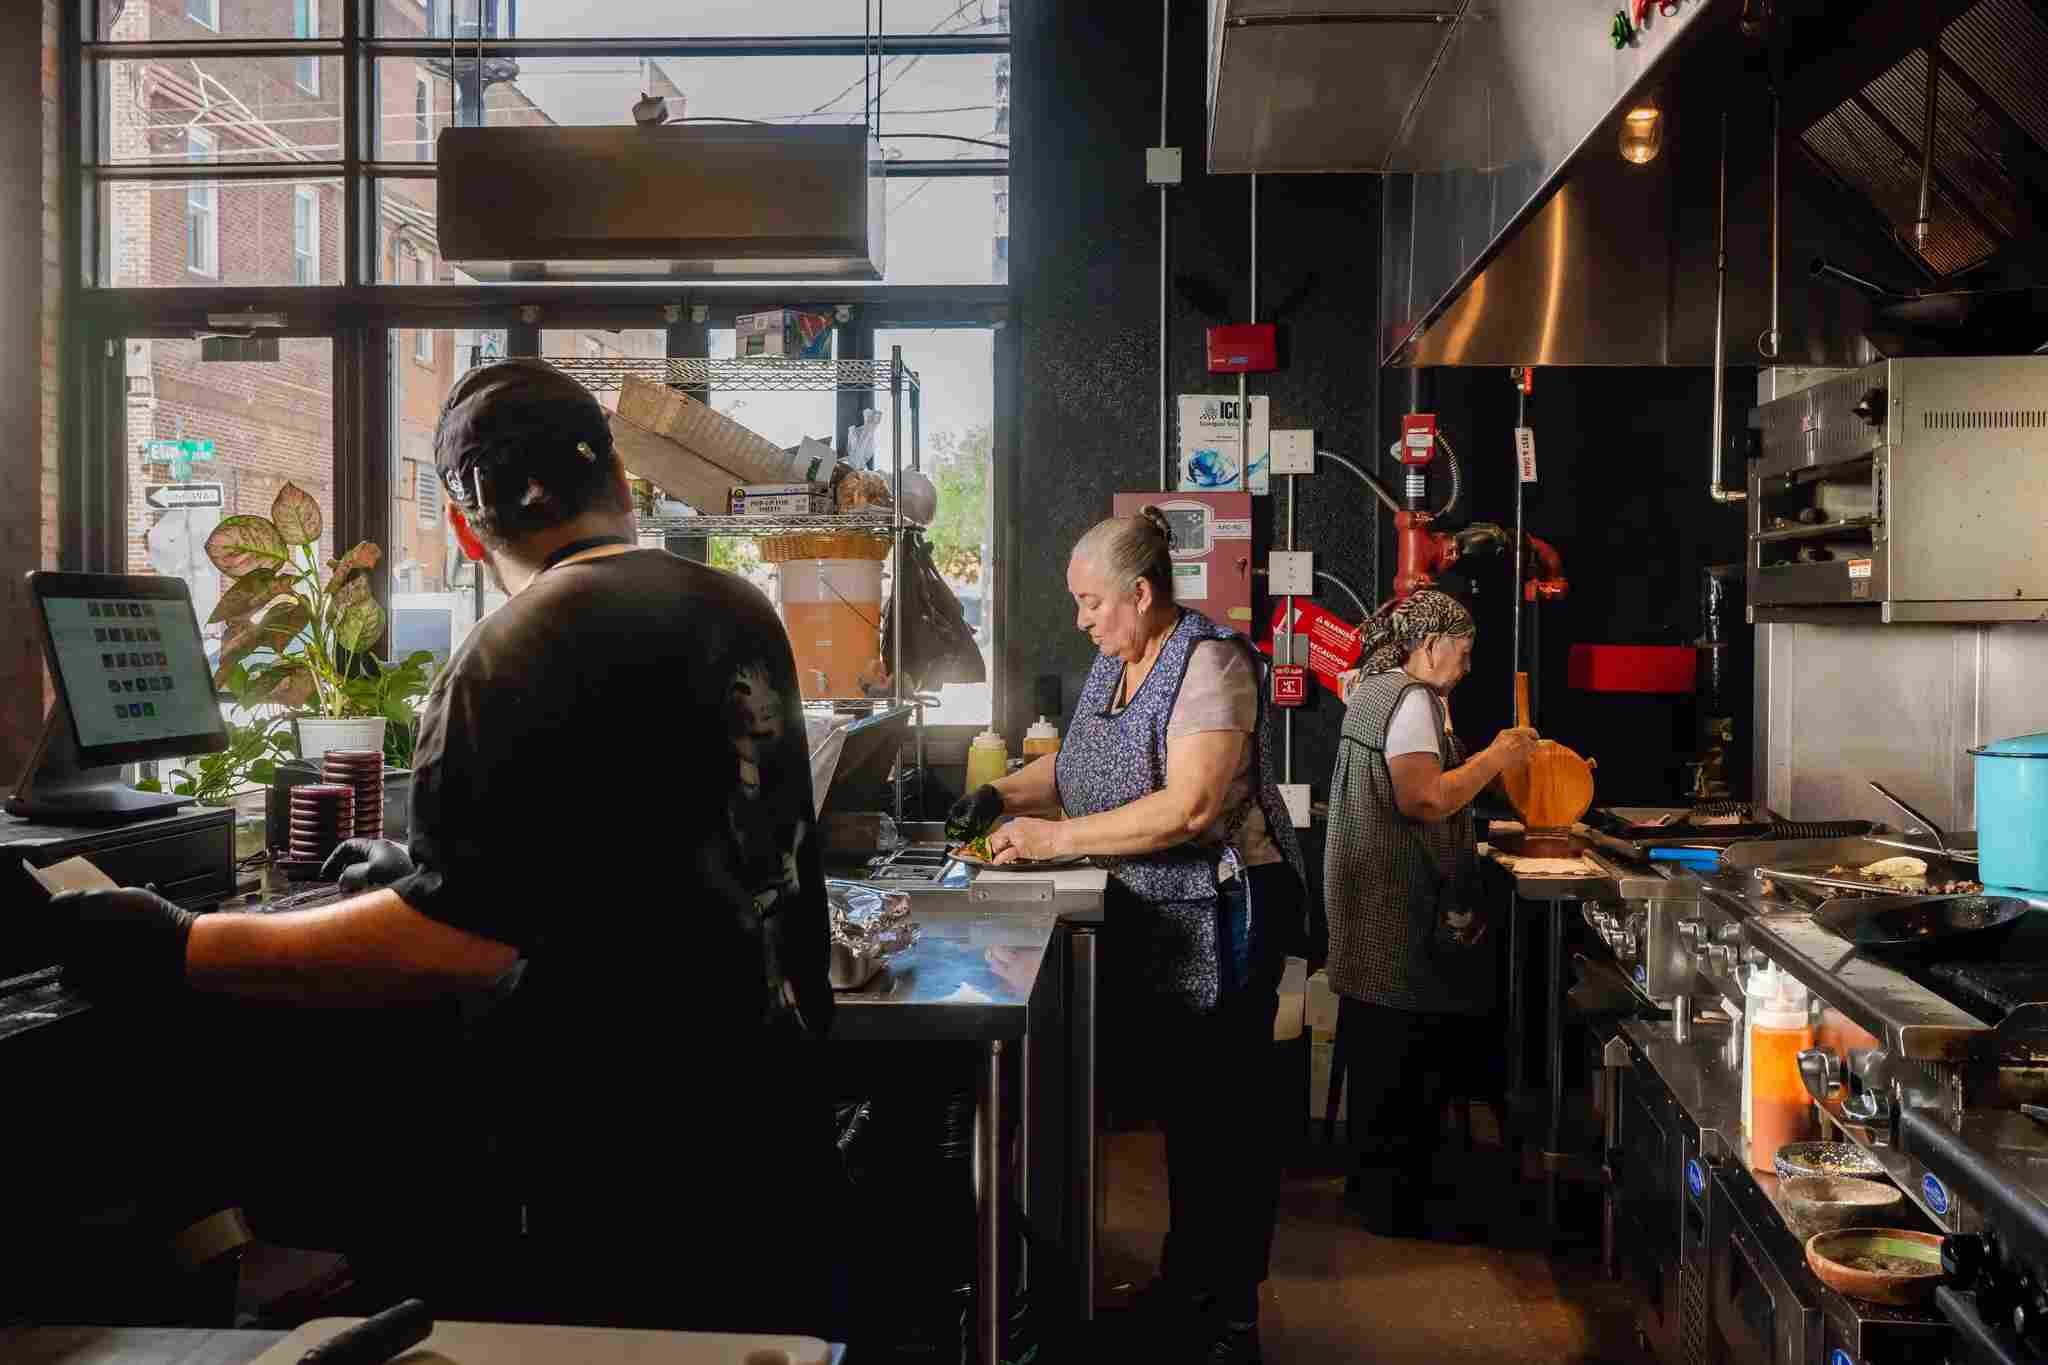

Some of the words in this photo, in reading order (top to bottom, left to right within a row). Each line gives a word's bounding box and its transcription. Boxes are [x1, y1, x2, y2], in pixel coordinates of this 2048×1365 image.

[1520, 433, 1529, 449] TEST
[1324, 619, 1355, 642] WARNING
[1310, 641, 1349, 669] RECAUCION
